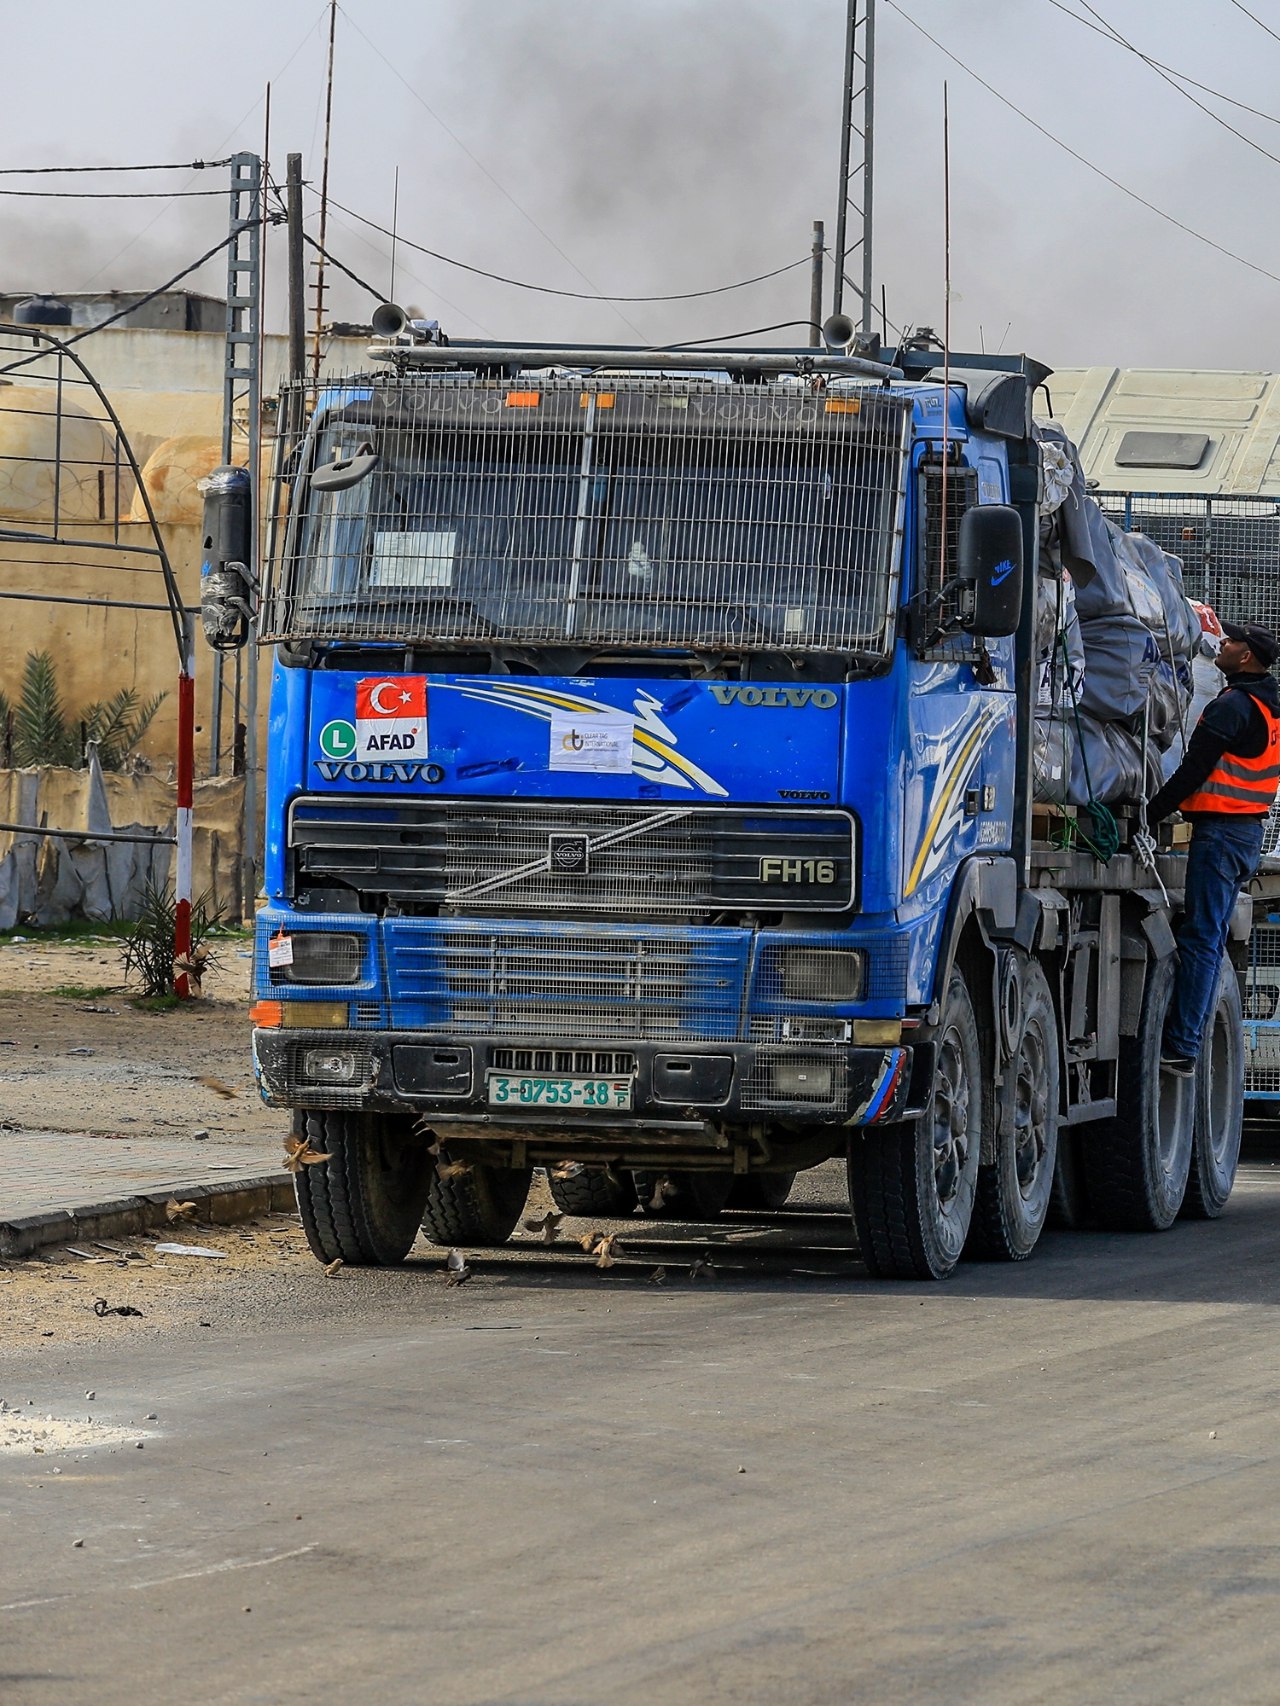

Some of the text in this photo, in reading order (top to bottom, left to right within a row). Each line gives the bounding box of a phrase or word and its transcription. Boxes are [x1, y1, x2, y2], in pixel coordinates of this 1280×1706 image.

[378, 393, 502, 414] VOLVO
[690, 400, 818, 423] VOLVO
[708, 685, 838, 708] VOLVO
[332, 730, 347, 748] L
[366, 734, 415, 751] AFAD
[313, 761, 445, 783] VOLVO
[776, 789, 831, 800] VOLVO
[762, 859, 834, 883] FH16
[496, 1078, 609, 1105] 3-0753-18
